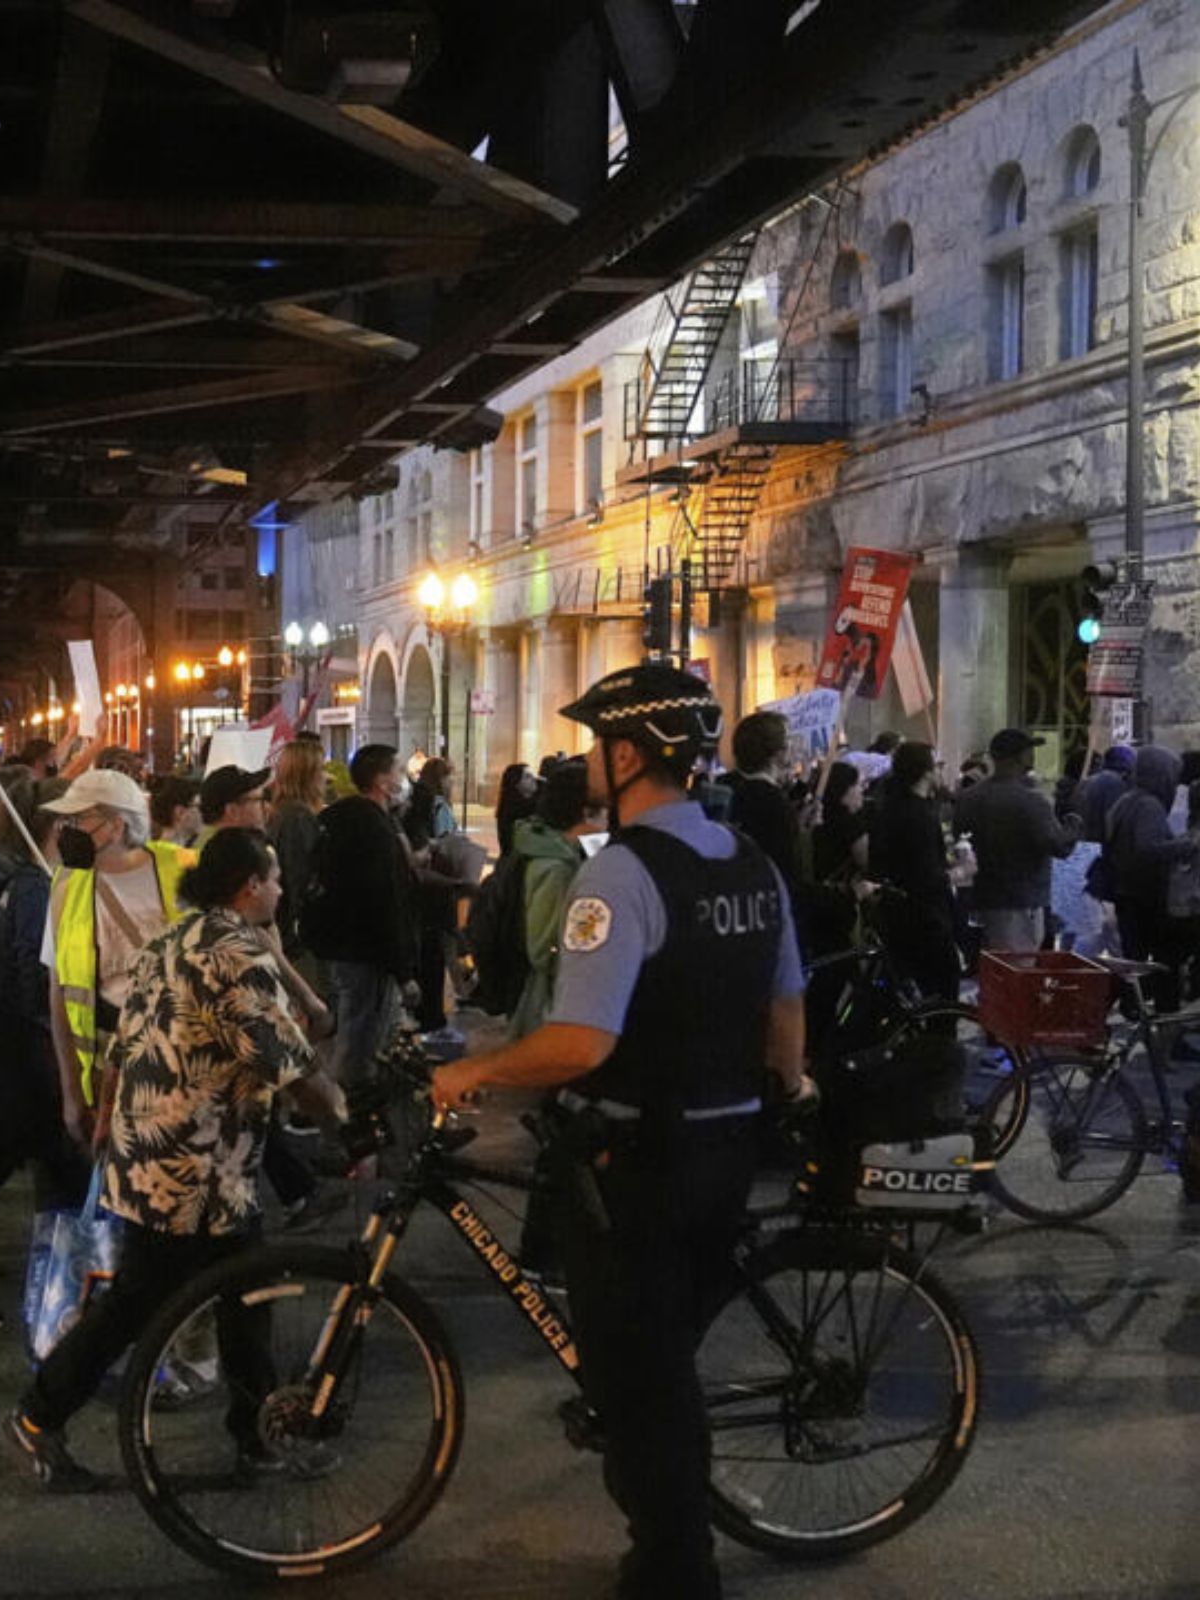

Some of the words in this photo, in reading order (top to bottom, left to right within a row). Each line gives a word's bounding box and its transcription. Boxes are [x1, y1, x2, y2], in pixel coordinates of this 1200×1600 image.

[862, 1166, 971, 1193] POLICE
[451, 1201, 518, 1282] CHICAGO
[513, 1281, 569, 1351] POLICE
